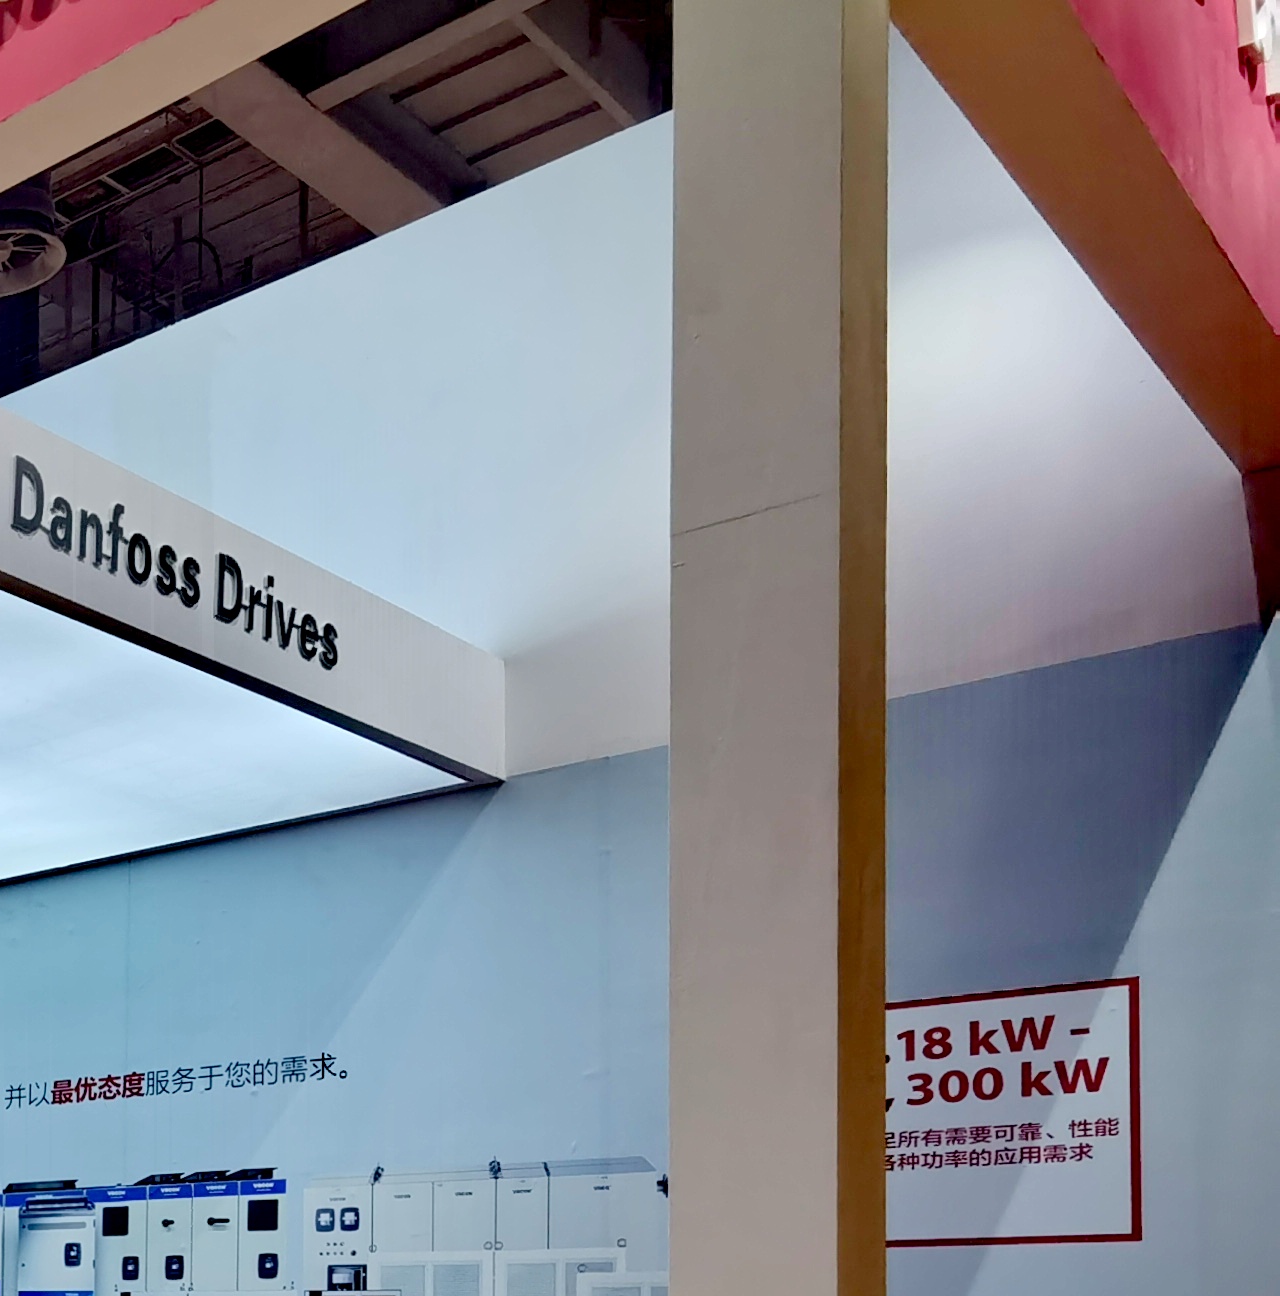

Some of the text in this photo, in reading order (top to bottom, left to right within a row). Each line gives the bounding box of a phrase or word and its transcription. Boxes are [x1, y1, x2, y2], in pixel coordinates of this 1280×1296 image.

[11, 455, 339, 670] Danfoss Drives
[968, 1014, 1056, 1056] kW
[1020, 1056, 1110, 1098] kW
